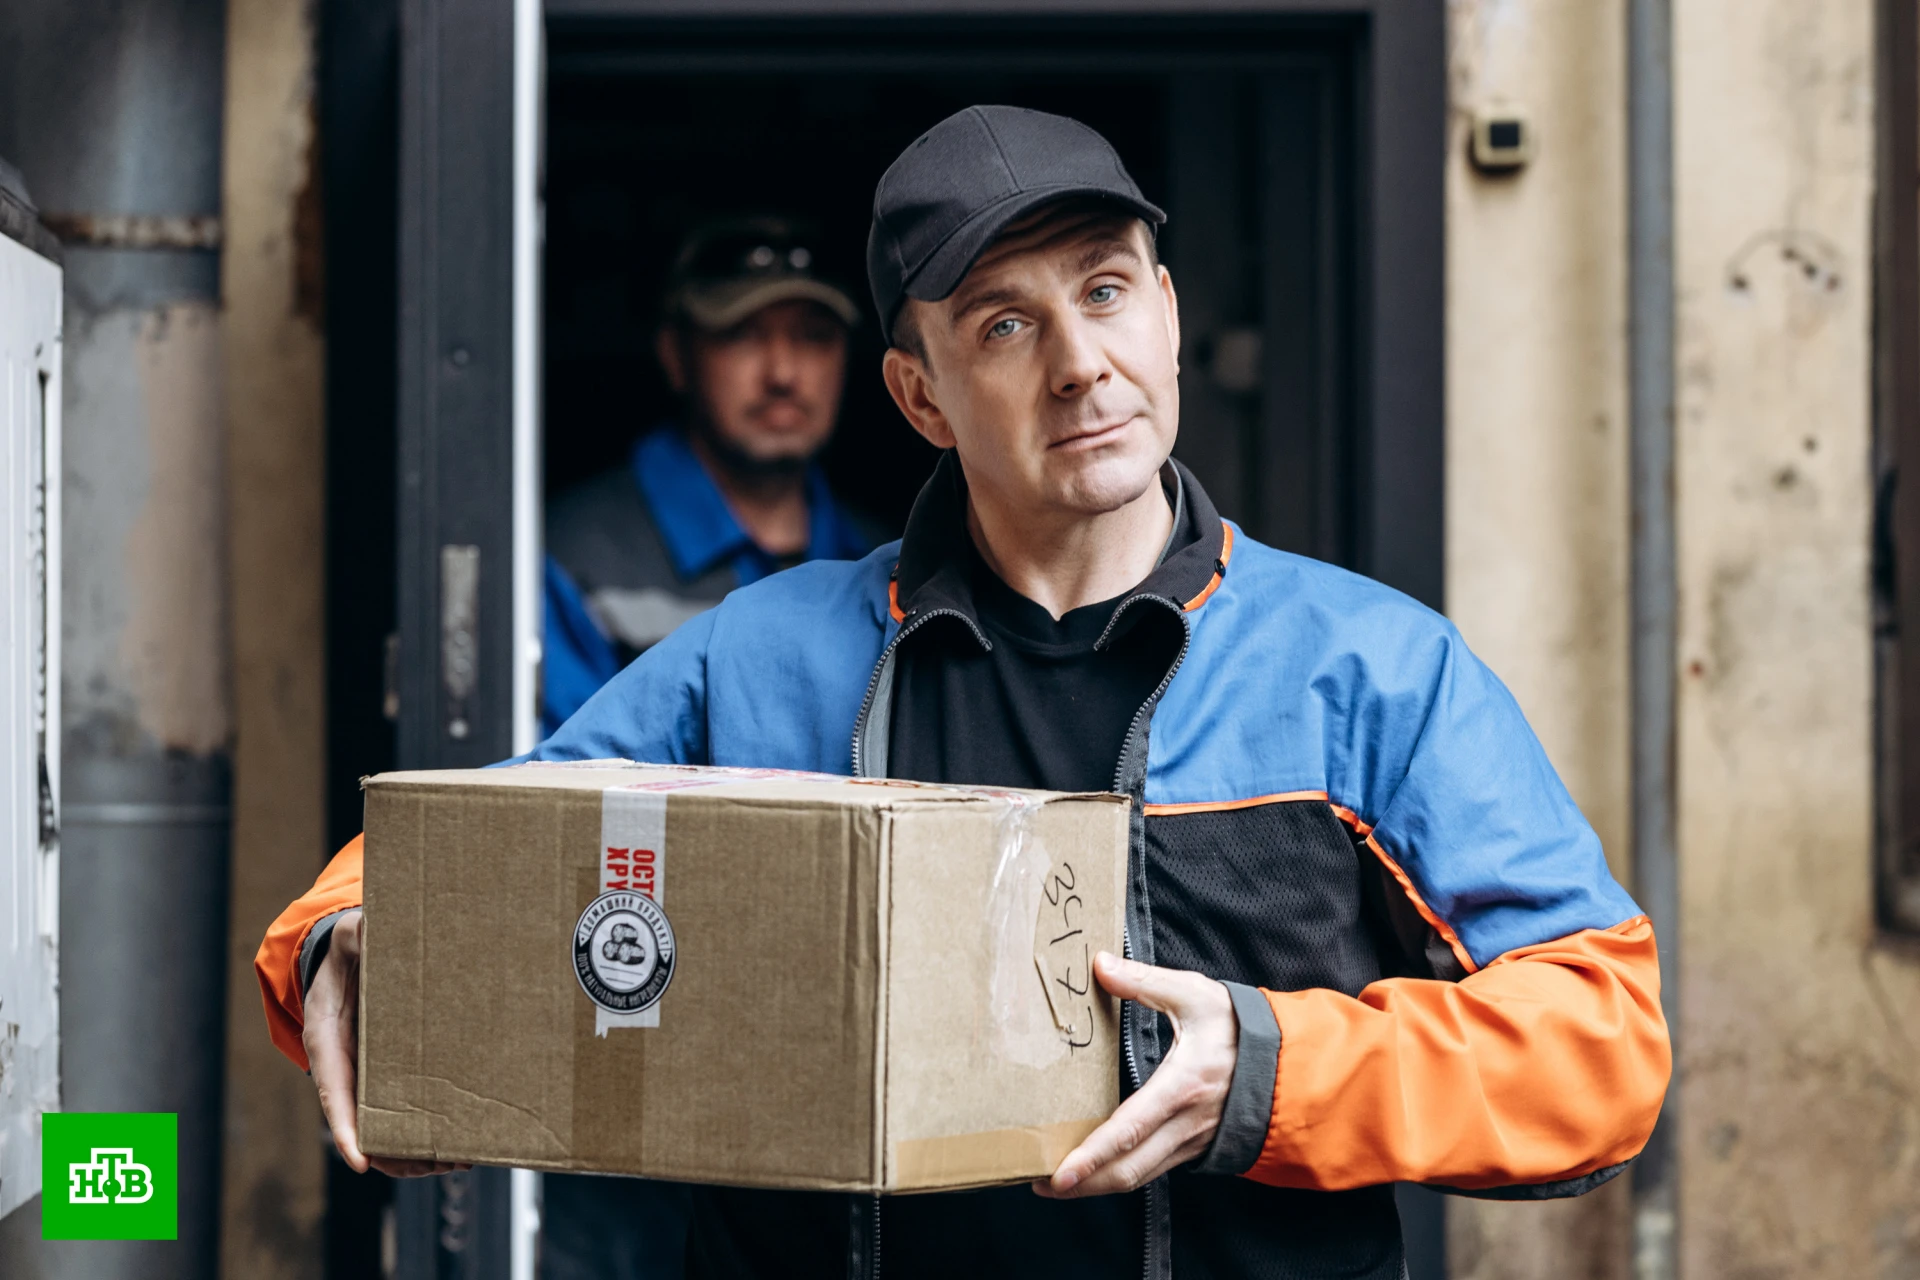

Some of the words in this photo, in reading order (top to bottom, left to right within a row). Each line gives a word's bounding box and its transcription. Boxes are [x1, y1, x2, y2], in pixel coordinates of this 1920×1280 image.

[632, 849, 656, 900] ОСТ
[582, 896, 634, 933] ДОМАШНИЙ
[637, 902, 670, 950] ПРОДУКТ
[577, 952, 590, 976] 100%
